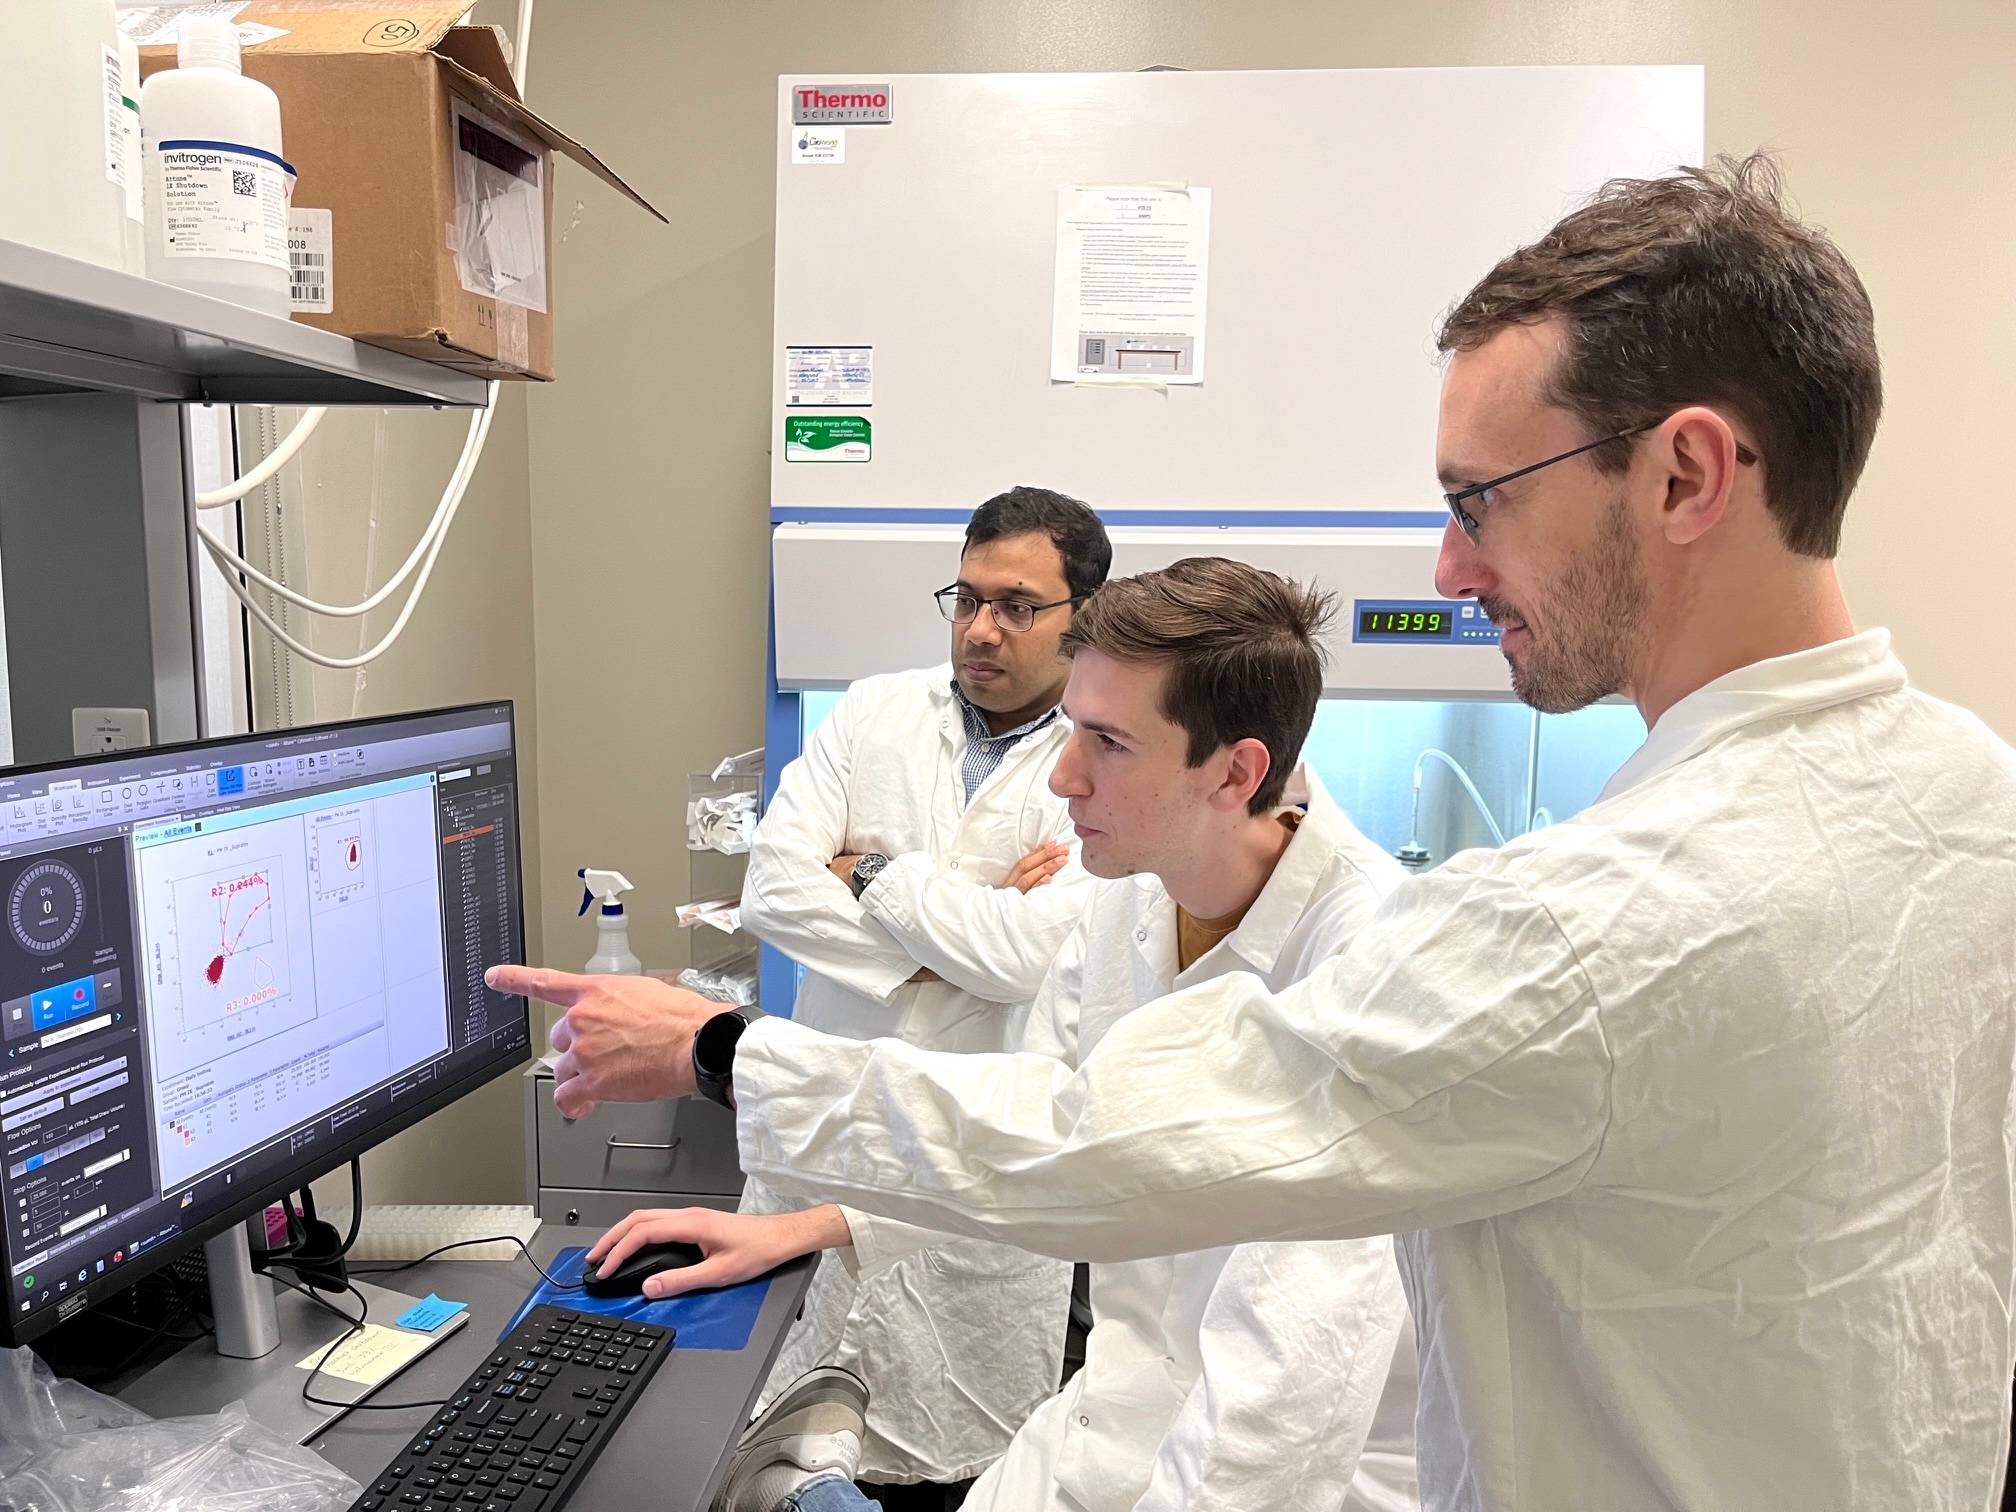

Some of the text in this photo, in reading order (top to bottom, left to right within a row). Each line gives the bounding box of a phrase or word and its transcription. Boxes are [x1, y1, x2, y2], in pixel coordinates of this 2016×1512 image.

[798, 90, 887, 108] Thermo
[802, 110, 885, 119] SCIENTIFIC
[164, 152, 222, 165] invitrogen
[288, 240, 306, 250] 008
[793, 420, 823, 428] Outstanding
[840, 420, 864, 428] efficiency
[1371, 613, 1440, 631] 11399
[135, 825, 192, 843] Preview All Events
[40, 886, 53, 896] 0%
[211, 887, 227, 897] R2:
[43, 900, 52, 914] 0
[46, 962, 64, 972] events
[226, 986, 277, 1012] R3: 0.000%
[71, 1001, 90, 1011] Record
[43, 1012, 54, 1020] Run
[18, 1042, 39, 1054] Sample
[9, 1065, 32, 1078] Protocol
[7, 1081, 34, 1095] Automatically
[48, 1068, 71, 1080] Experiment
[7, 1123, 42, 1141] Flow Options
[13, 1176, 47, 1195] Stop Options
[25, 1239, 40, 1251] Record
